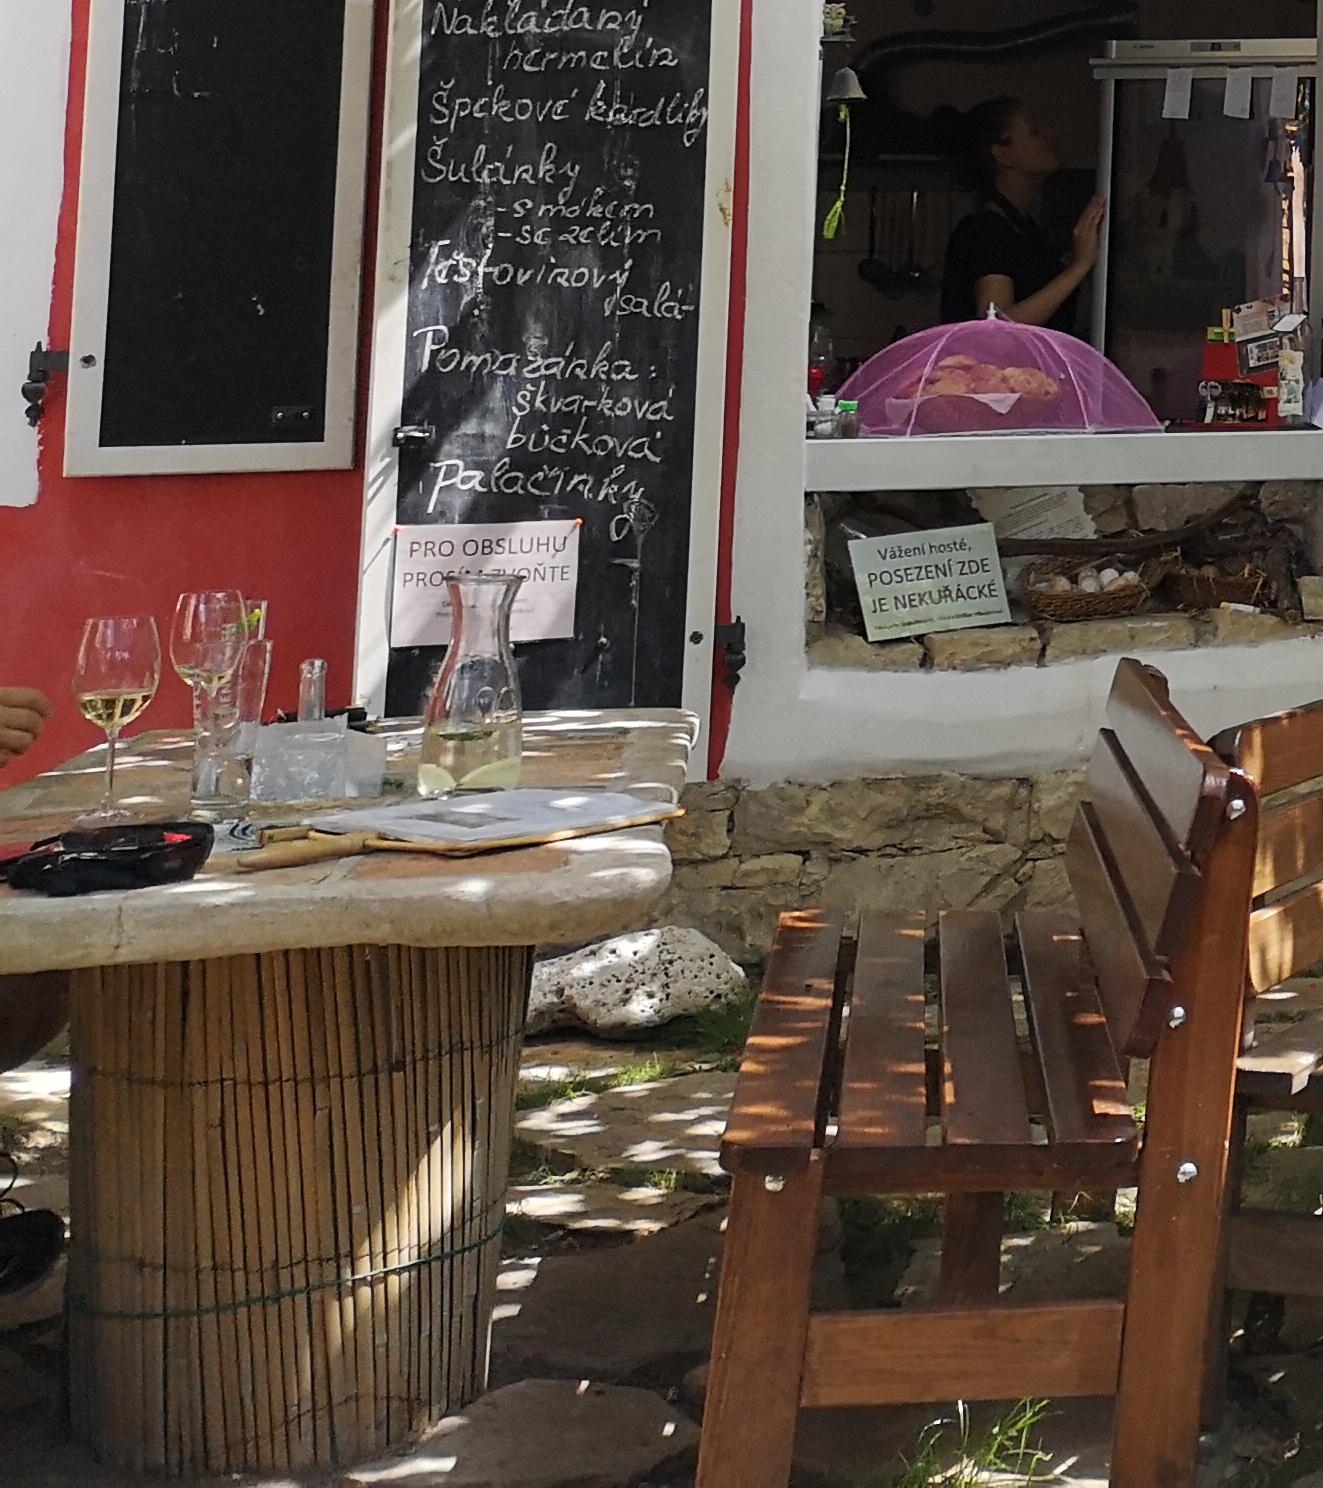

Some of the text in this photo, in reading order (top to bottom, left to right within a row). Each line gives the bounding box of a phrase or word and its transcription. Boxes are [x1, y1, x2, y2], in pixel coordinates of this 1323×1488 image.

[502, 37, 678, 72] hermelín
[429, 78, 578, 133] Špekové
[421, 135, 580, 204] Šulánky
[409, 535, 568, 558] PRO OBSLUHU
[877, 537, 972, 561] Vážení hosté,
[867, 557, 991, 588] POSEZENÍ ZDE
[871, 578, 999, 614] JE NEKUŘÁCKÉ
